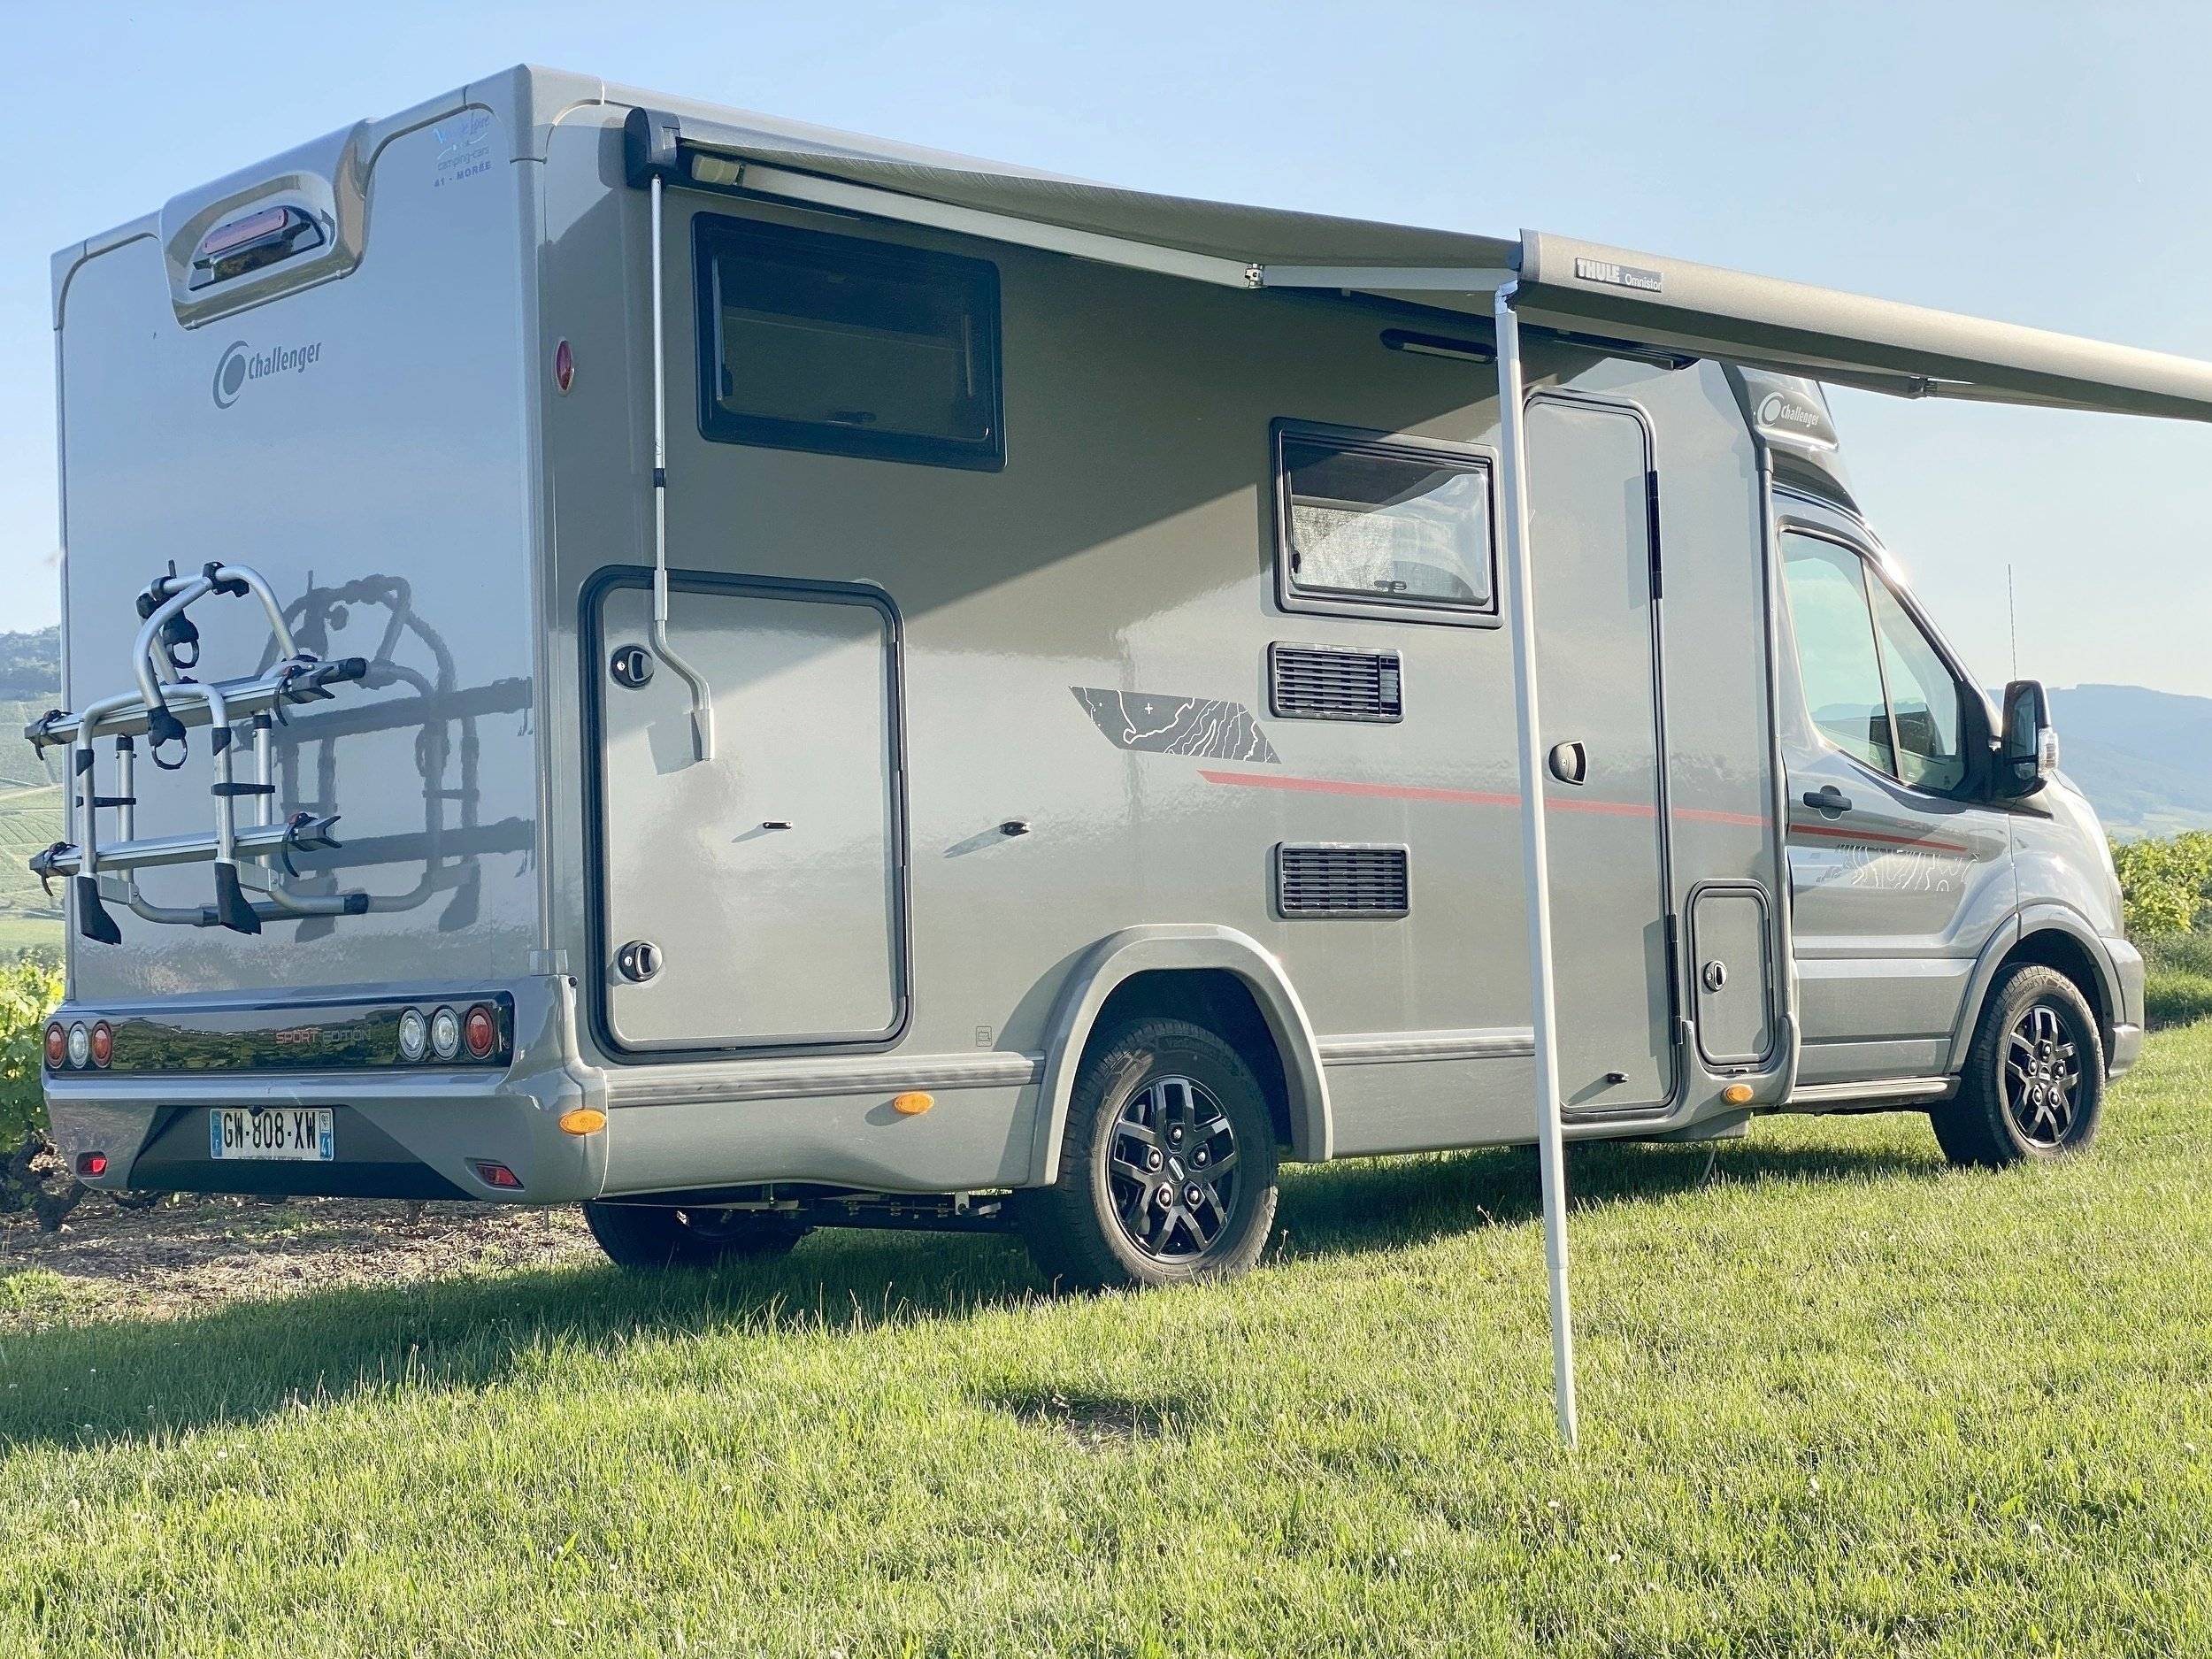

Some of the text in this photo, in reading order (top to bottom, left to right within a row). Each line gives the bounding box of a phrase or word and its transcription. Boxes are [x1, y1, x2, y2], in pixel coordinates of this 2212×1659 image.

[1577, 258, 1663, 292] THULE Omnistor
[248, 342, 322, 380] Challenger
[1780, 403, 1820, 428] Challenger
[275, 1031, 319, 1045] SPORT
[223, 1111, 316, 1149] GW-808-XW
[320, 1137, 331, 1156] 41
